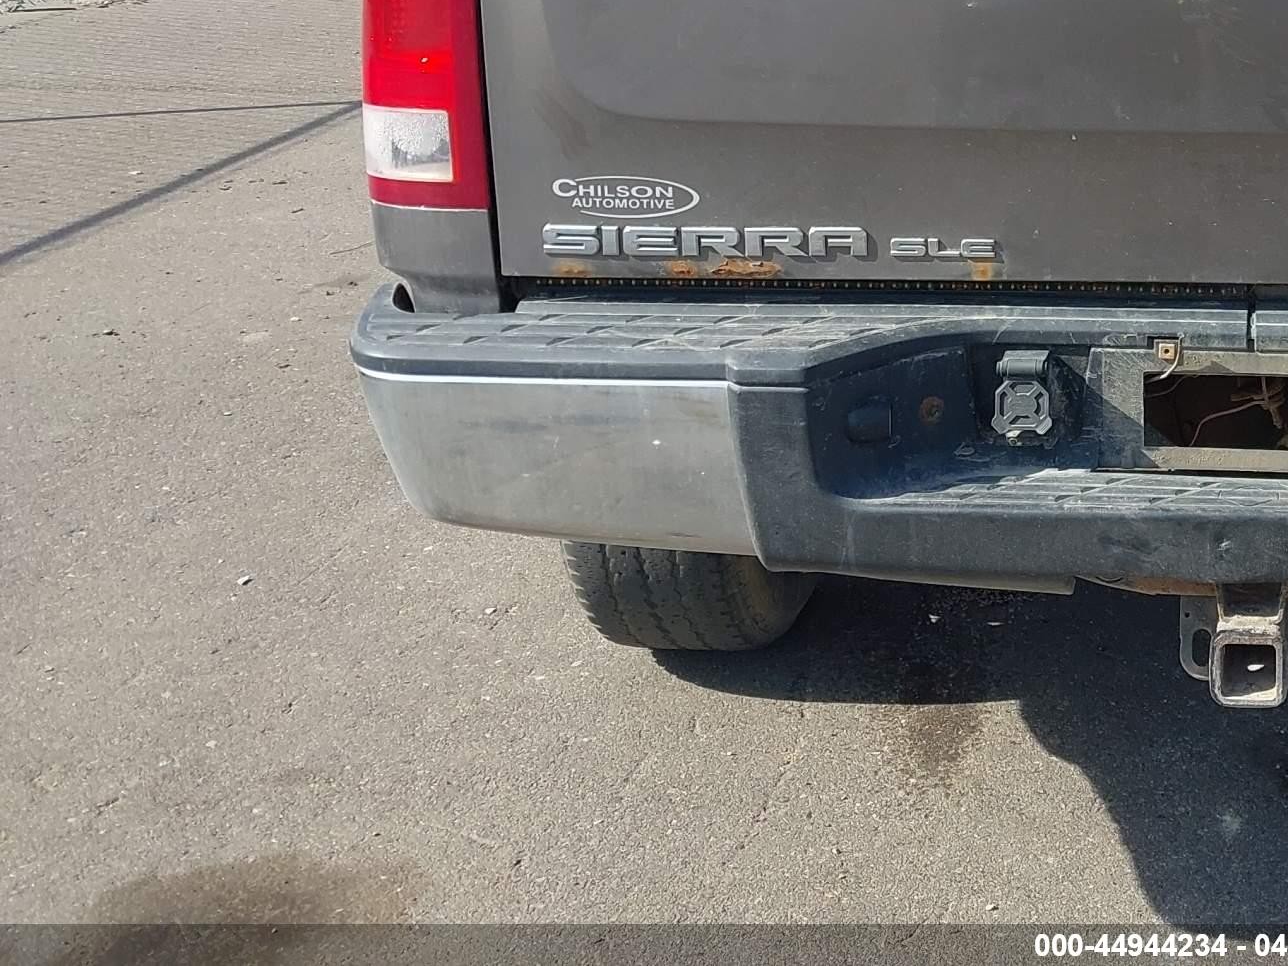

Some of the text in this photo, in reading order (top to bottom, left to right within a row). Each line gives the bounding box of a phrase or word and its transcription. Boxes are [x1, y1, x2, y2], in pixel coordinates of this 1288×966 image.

[552, 178, 674, 198] CHILSON
[571, 197, 675, 210] AUTOMOTIVE
[542, 224, 997, 258] SIERRA SLE
